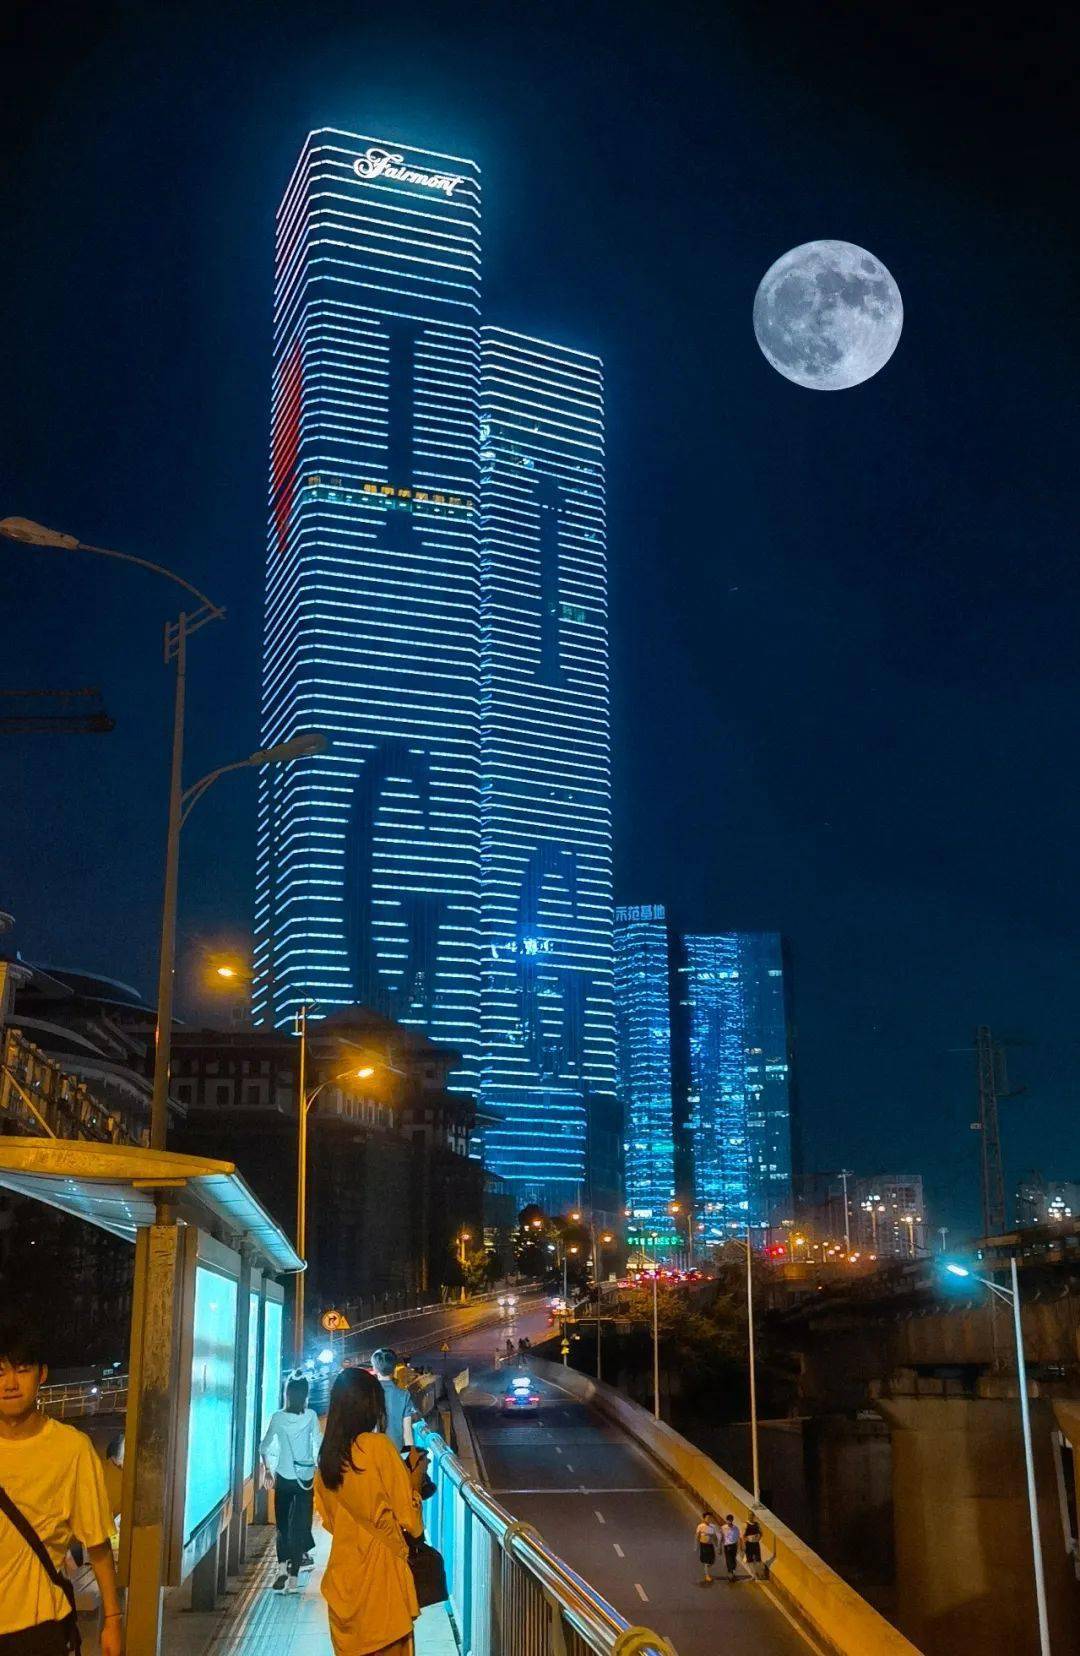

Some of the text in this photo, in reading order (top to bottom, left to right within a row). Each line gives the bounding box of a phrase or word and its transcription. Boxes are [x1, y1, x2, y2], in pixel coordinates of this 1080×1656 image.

[353, 148, 464, 196] Fairmont
[616, 904, 665, 921] 示范基地
